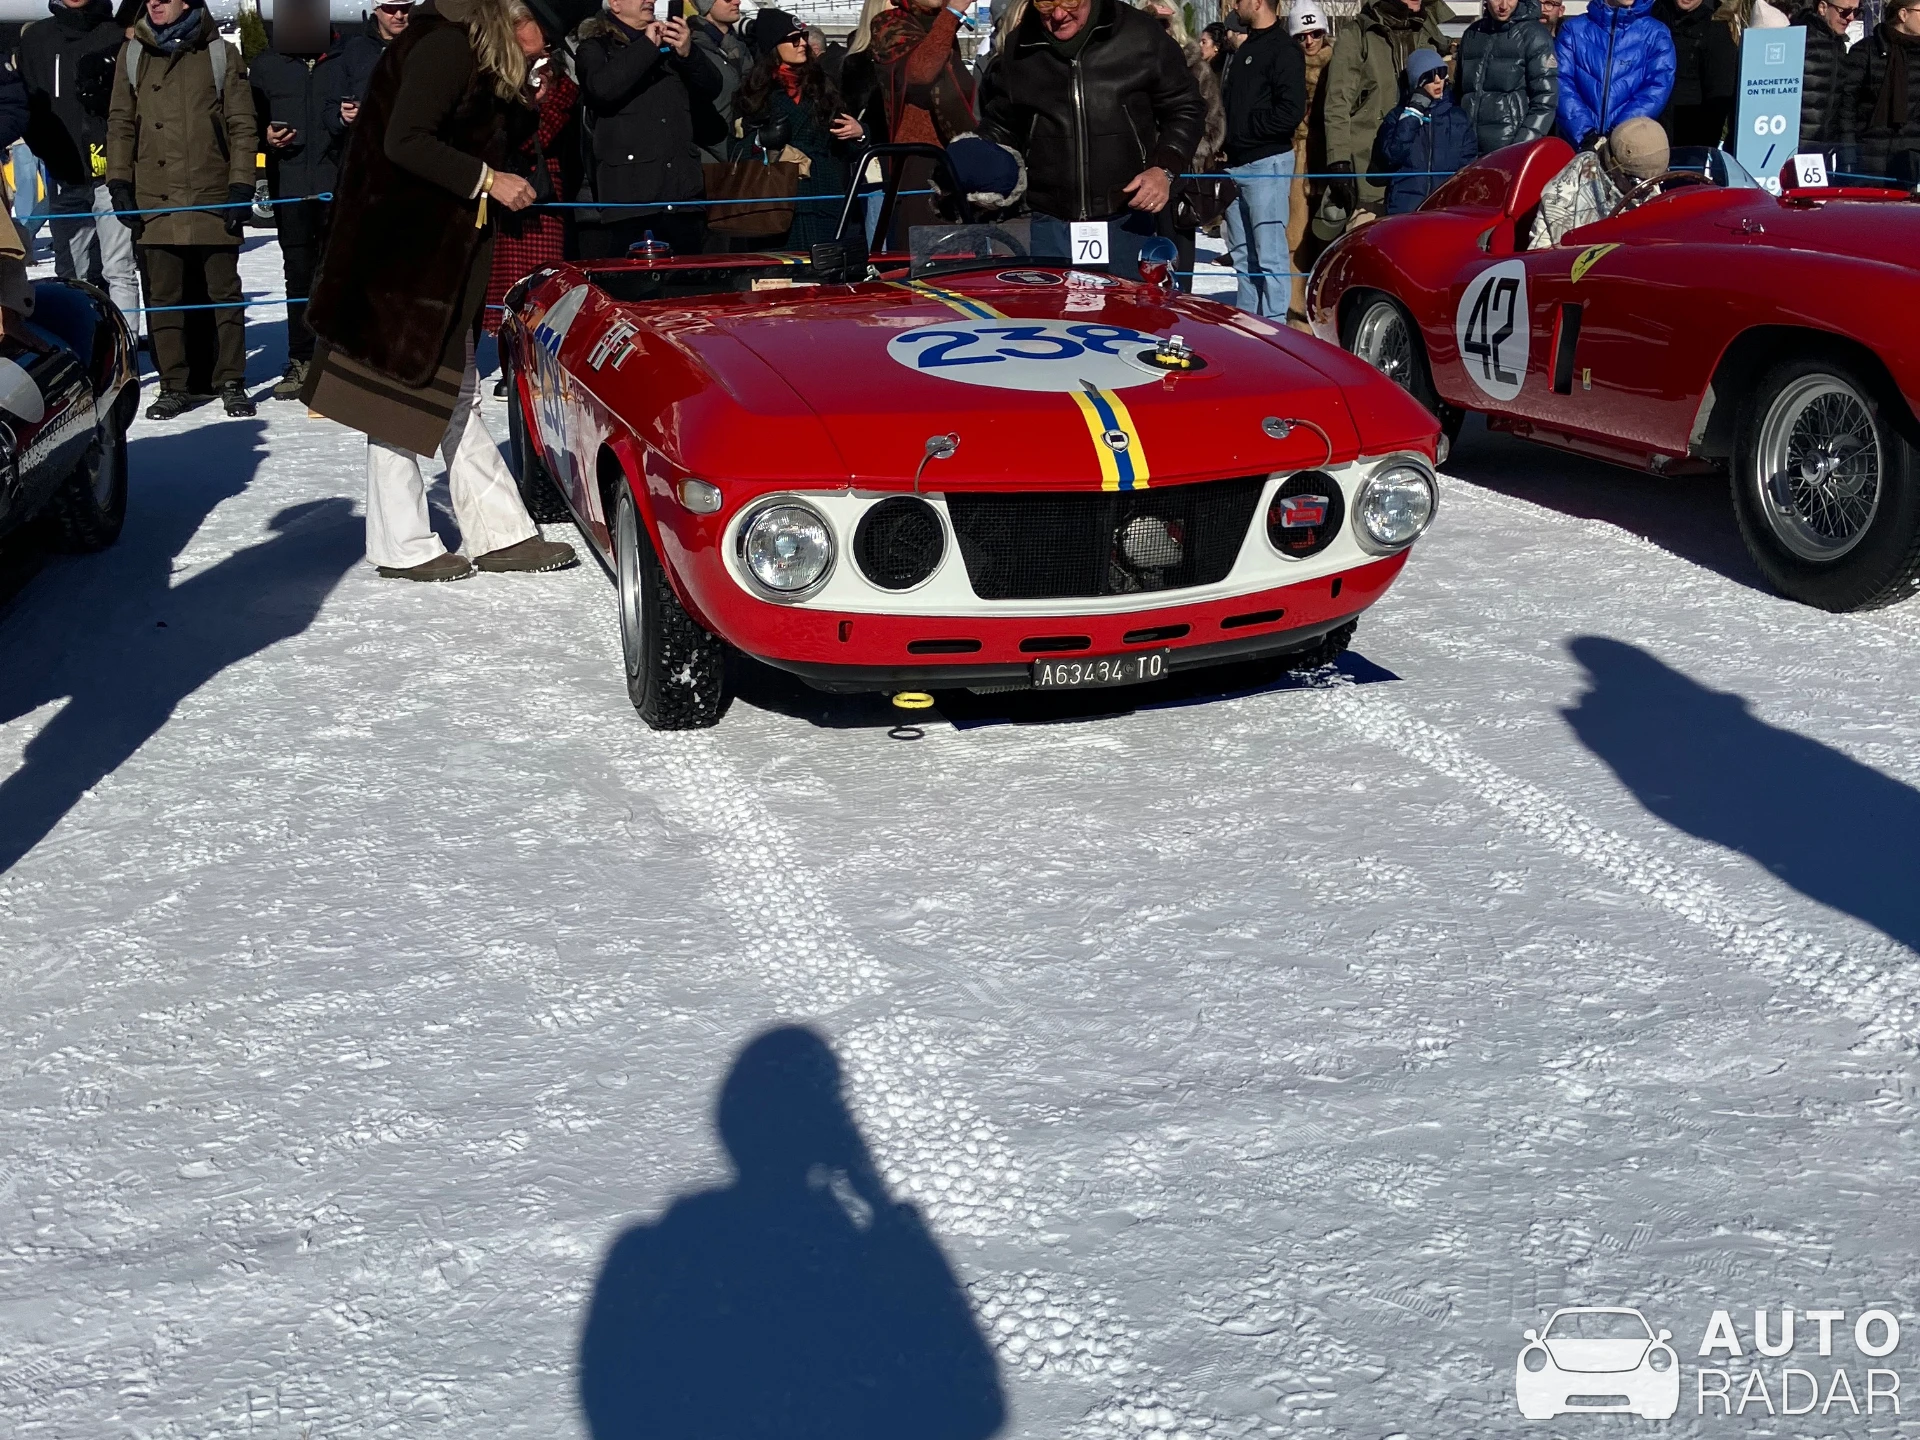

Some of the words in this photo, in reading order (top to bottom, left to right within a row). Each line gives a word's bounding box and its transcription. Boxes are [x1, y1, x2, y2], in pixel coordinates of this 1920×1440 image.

[1747, 78, 1800, 86] BARCHETTA'S
[1747, 88, 1759, 96] ON
[1761, 87, 1776, 95] THE
[1778, 86, 1798, 94] LAKE
[1754, 114, 1787, 136] 60
[1760, 143, 1776, 169] /
[1803, 167, 1822, 184] 65
[1077, 239, 1103, 260] 70
[1463, 276, 1520, 386] 42
[896, 324, 1159, 369] 238
[1137, 654, 1162, 679] TO
